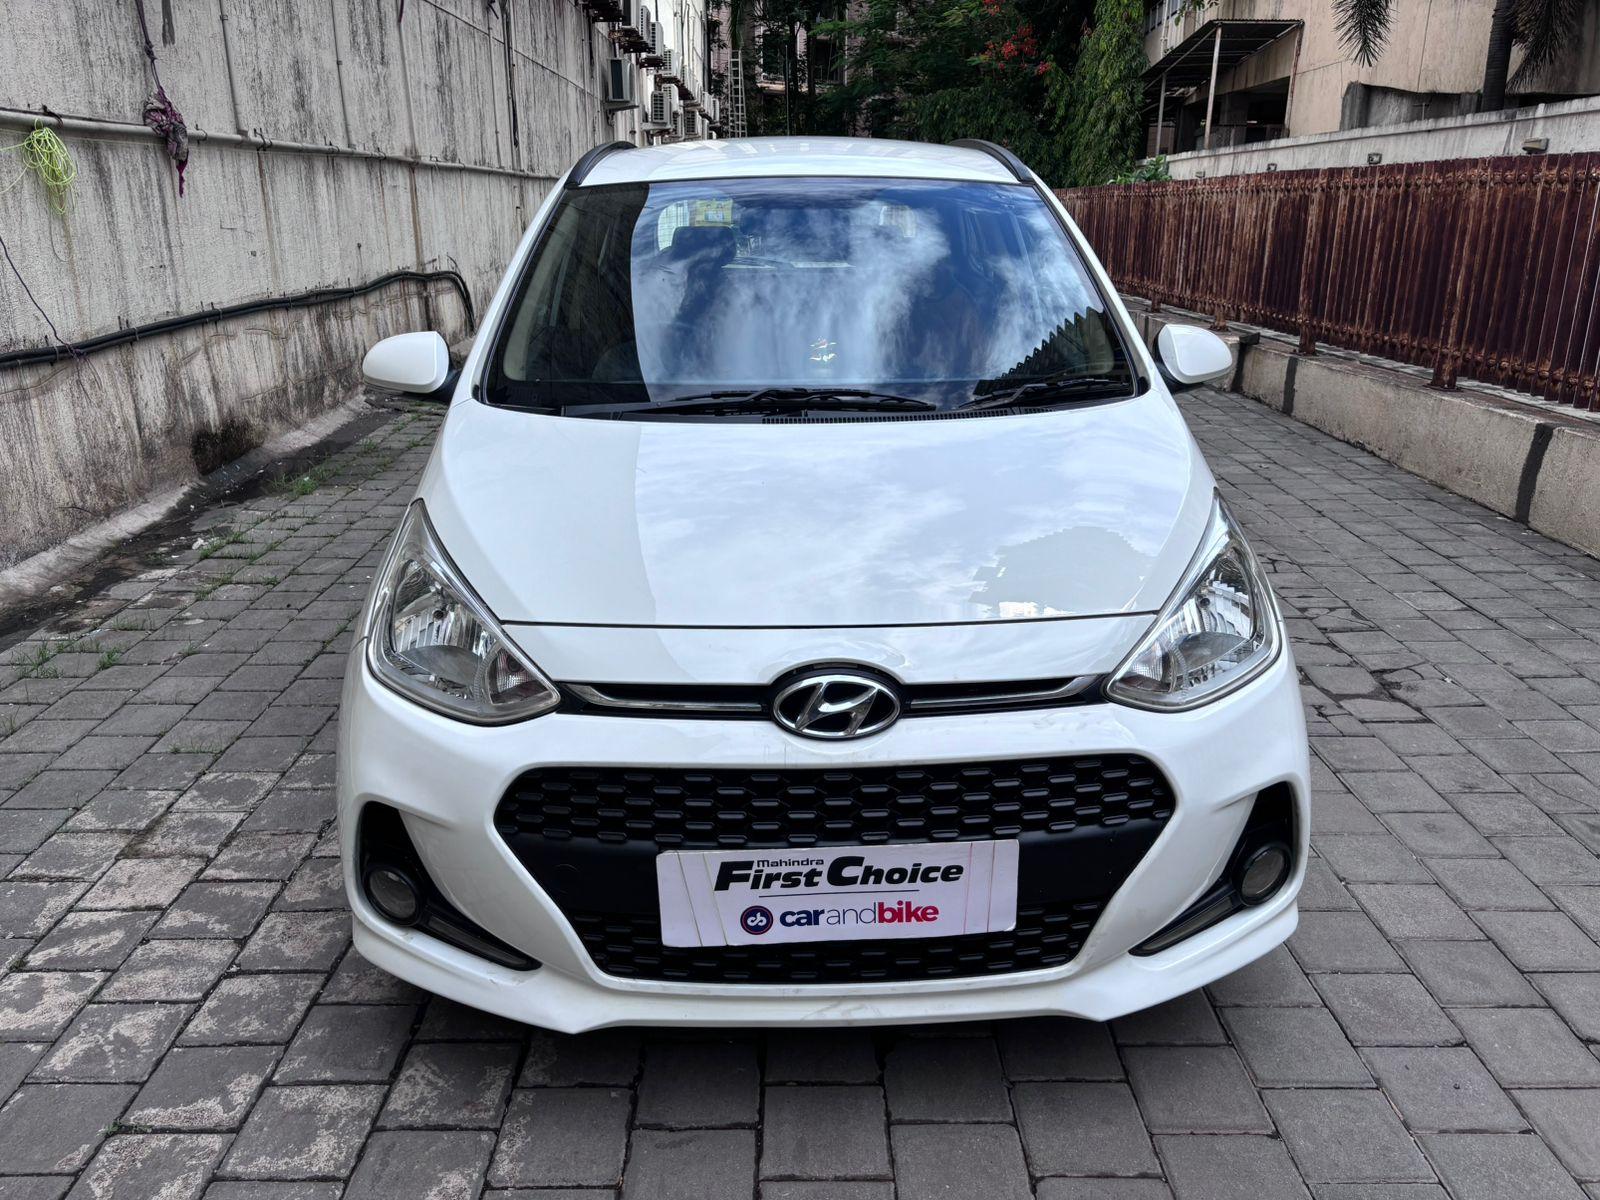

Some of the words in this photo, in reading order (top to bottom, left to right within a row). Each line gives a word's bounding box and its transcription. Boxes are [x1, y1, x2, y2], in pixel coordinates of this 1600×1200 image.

[714, 860, 823, 891] First
[827, 856, 964, 886] Choice
[757, 858, 824, 867] Mahindra
[780, 900, 939, 927] carandbike
